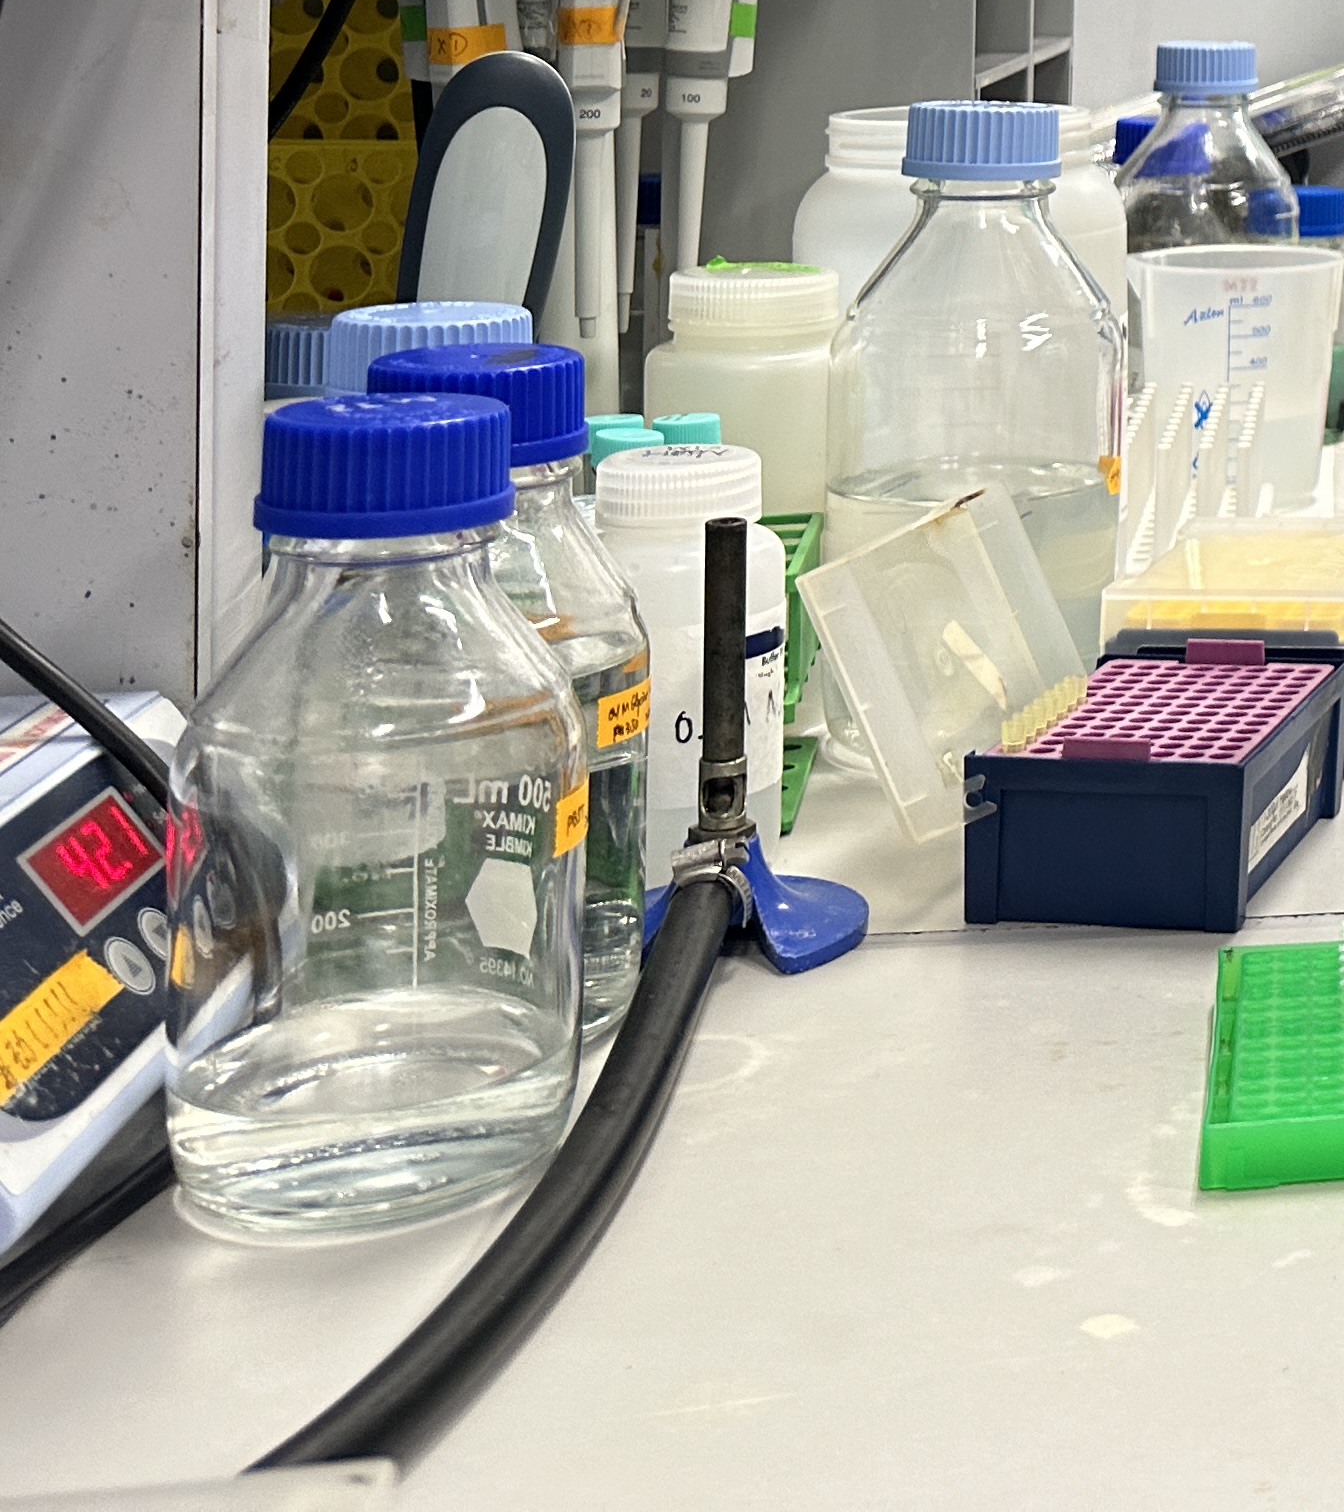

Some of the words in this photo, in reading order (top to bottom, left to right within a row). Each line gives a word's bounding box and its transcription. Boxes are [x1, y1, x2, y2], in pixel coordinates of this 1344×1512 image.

[640, 89, 652, 99] 20
[681, 93, 701, 104] 100
[579, 109, 601, 120] 200
[1183, 307, 1225, 326] Azlon
